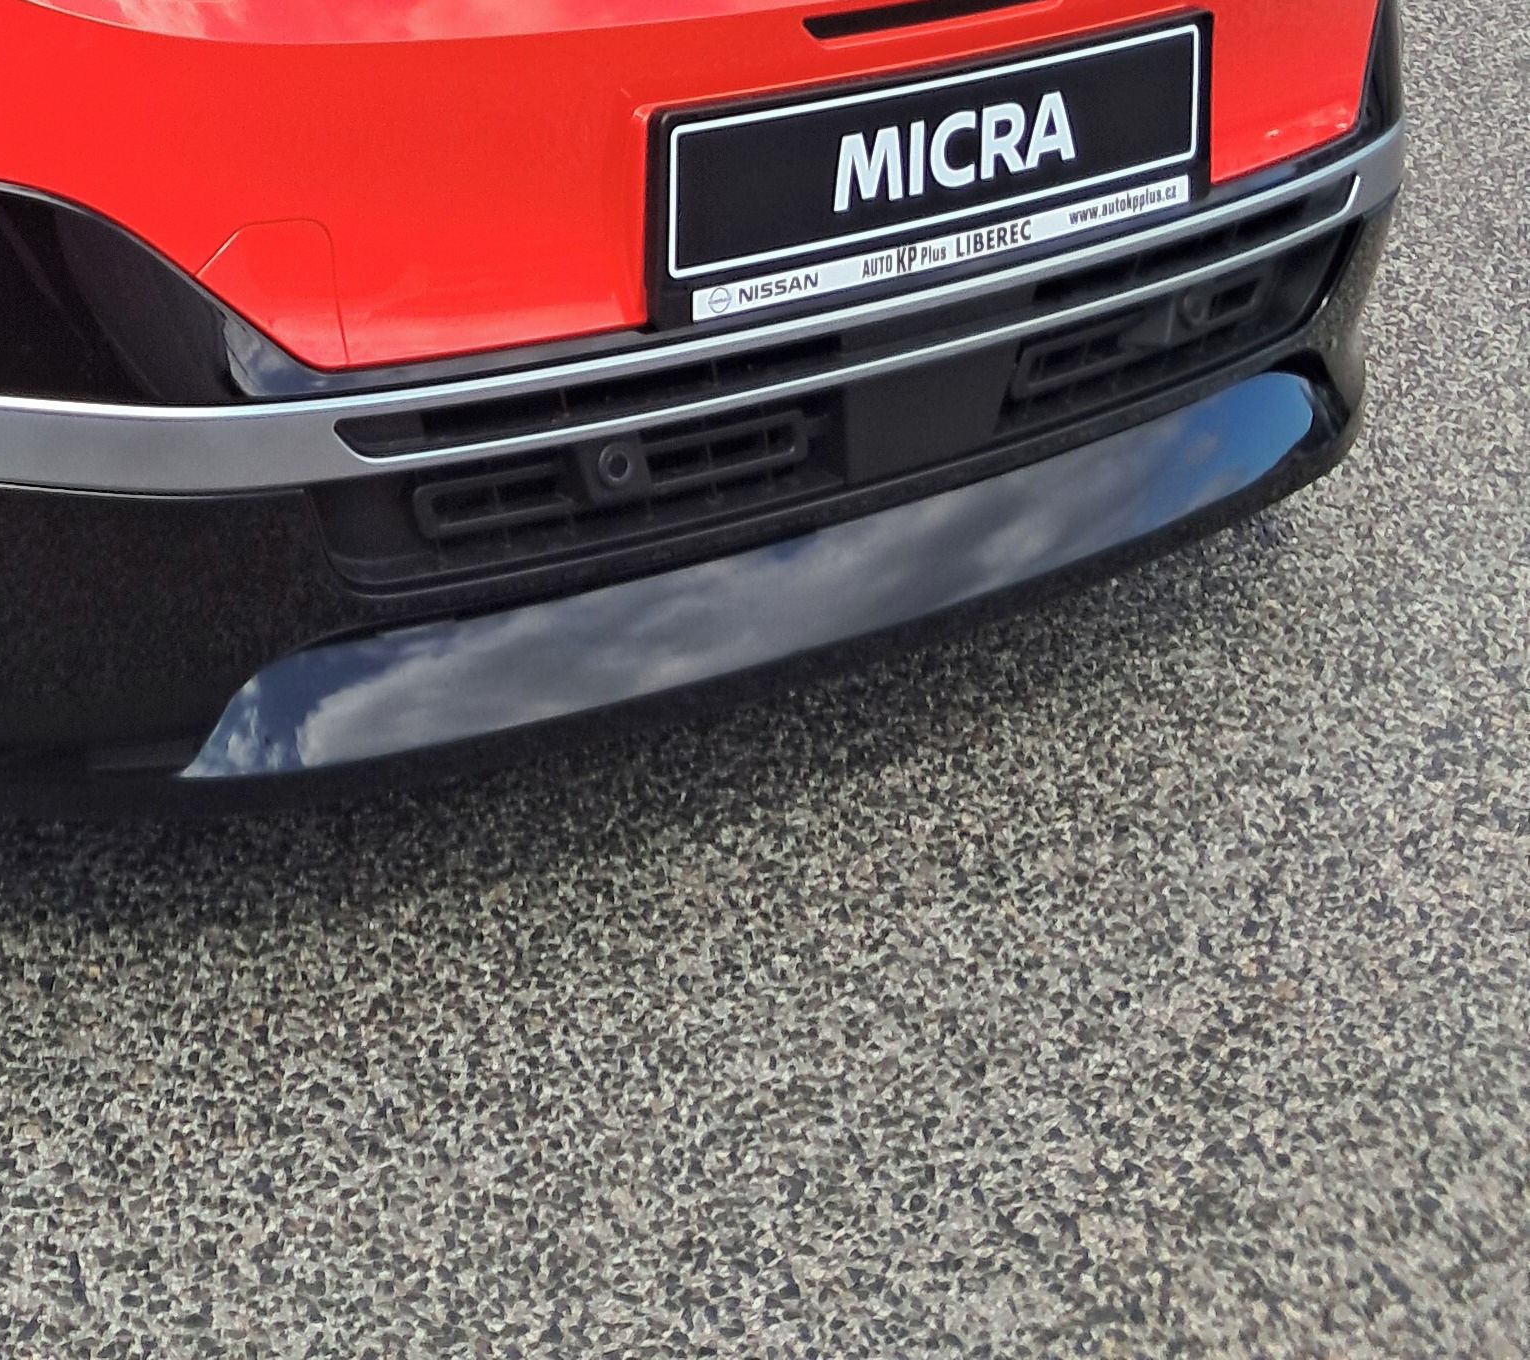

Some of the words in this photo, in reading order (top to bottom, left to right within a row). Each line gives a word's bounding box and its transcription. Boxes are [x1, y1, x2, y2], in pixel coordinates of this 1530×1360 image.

[833, 89, 1076, 213] MICRA
[738, 272, 819, 305] NISSAN
[861, 254, 893, 279] AUTO
[896, 243, 918, 274] KP
[920, 246, 947, 266] Plus
[955, 219, 1032, 258] LIBEREC
[1069, 184, 1177, 226] www.autokpplus.cz
